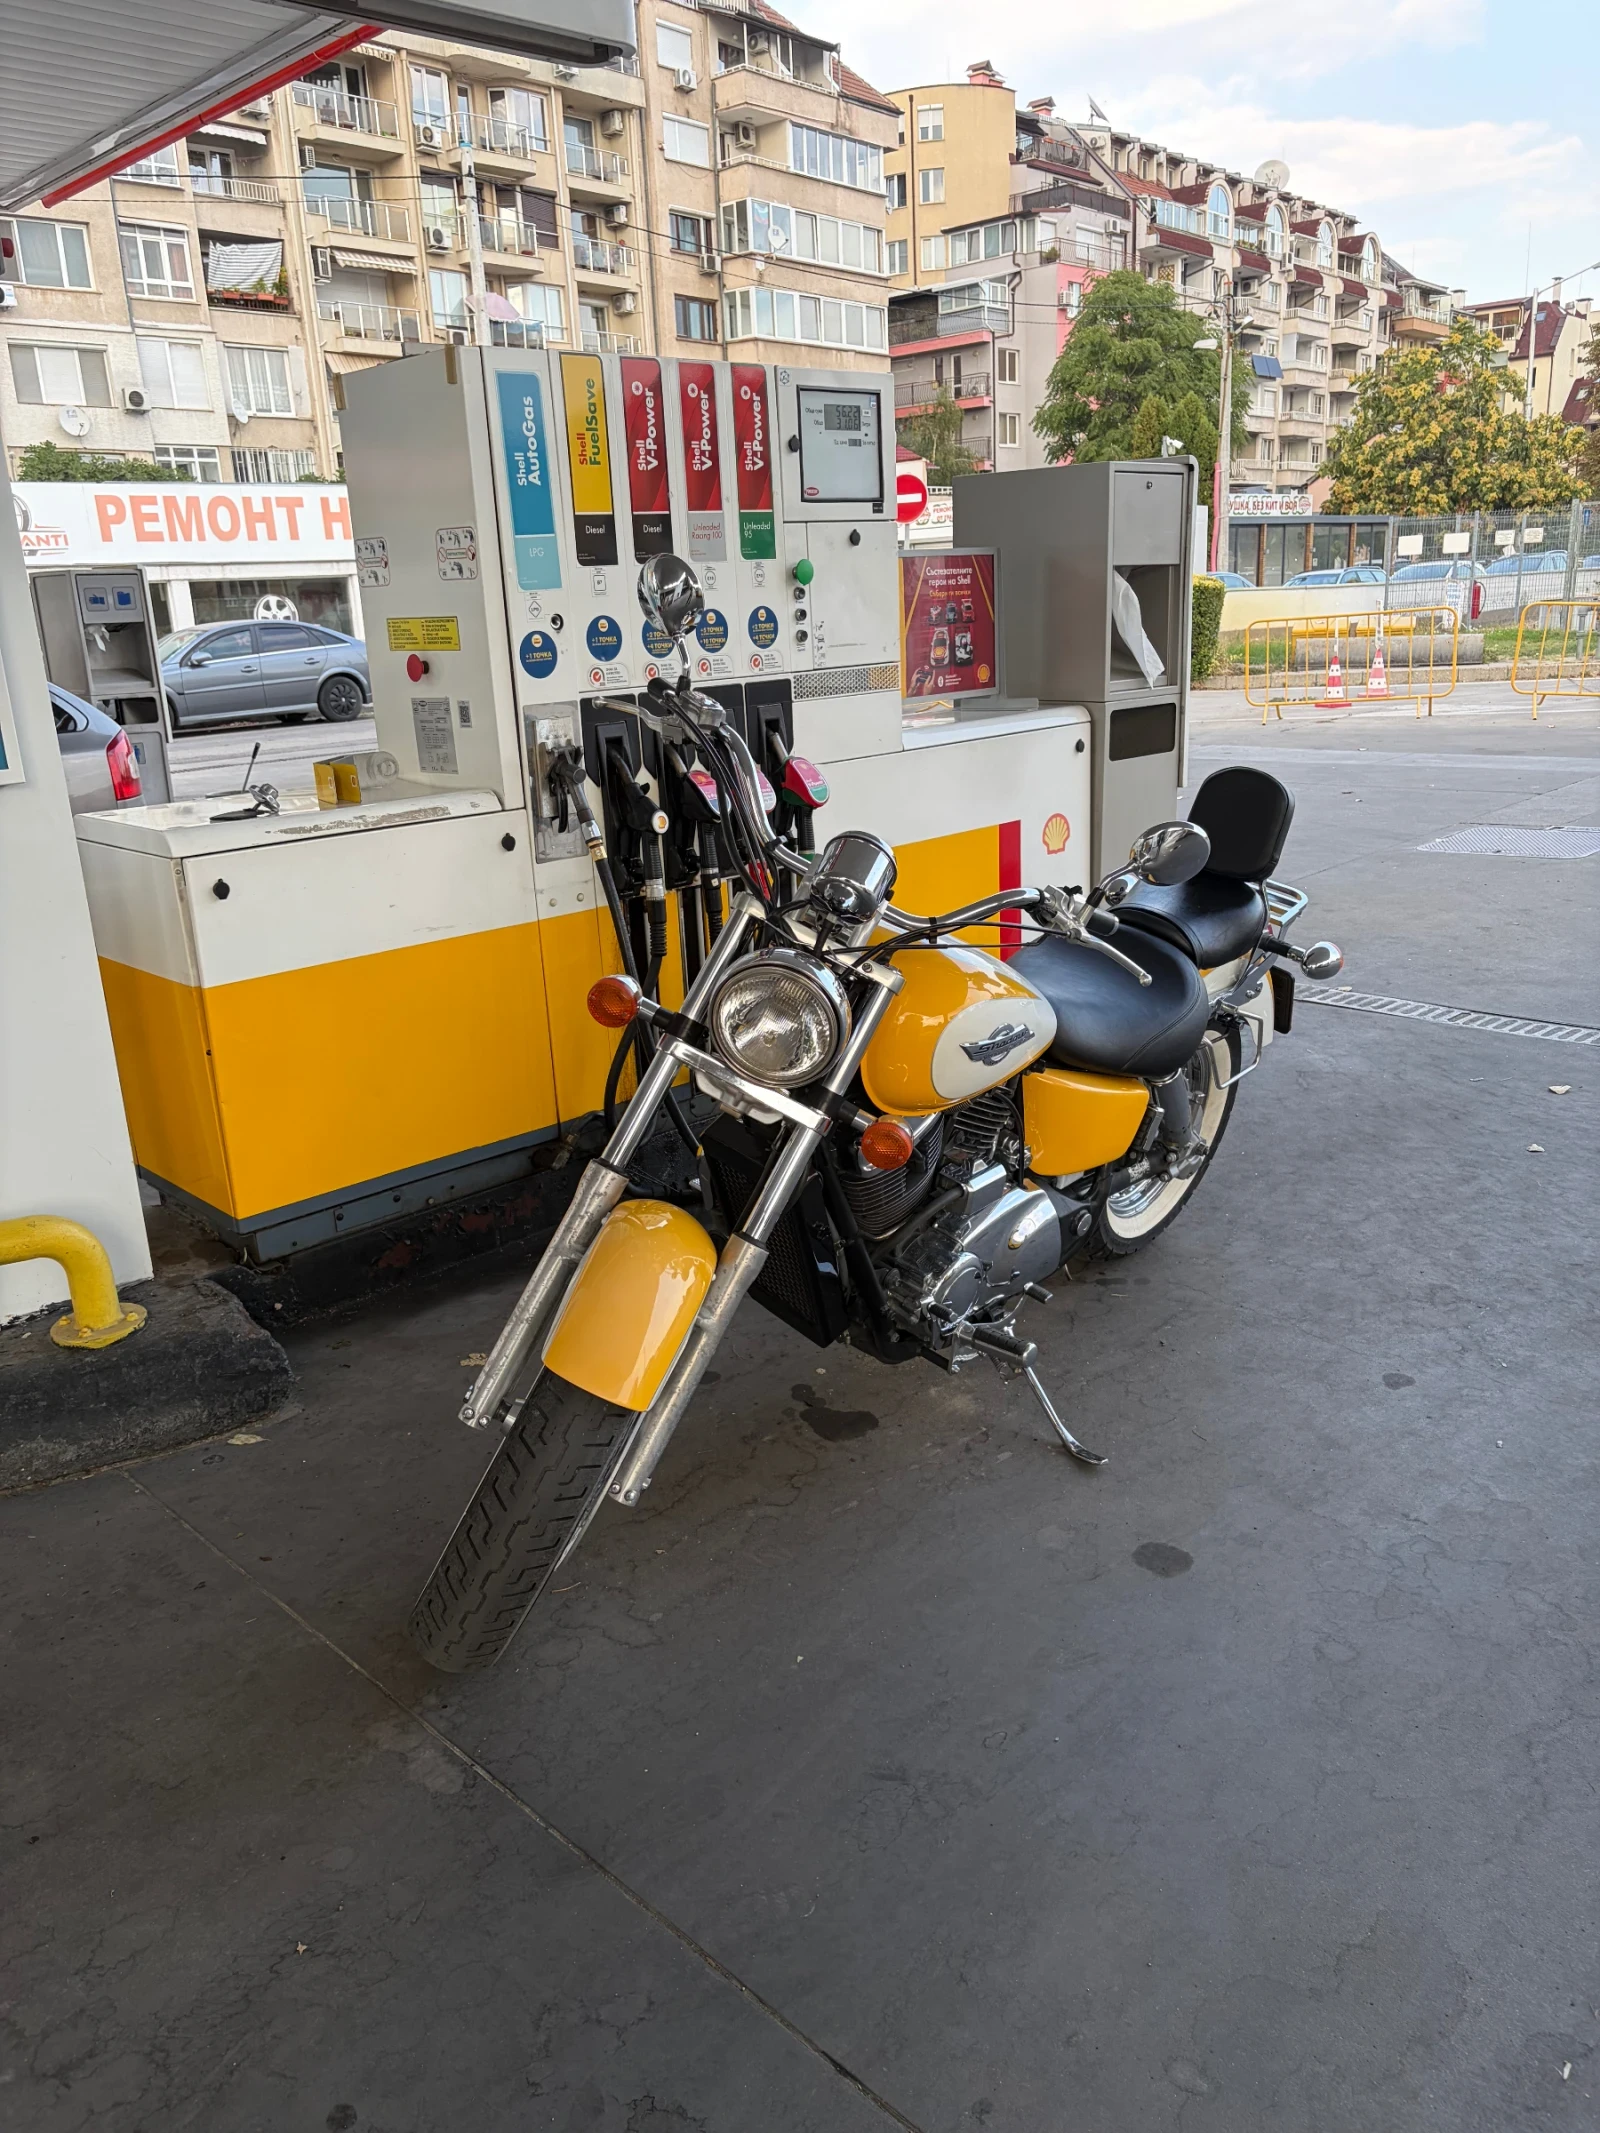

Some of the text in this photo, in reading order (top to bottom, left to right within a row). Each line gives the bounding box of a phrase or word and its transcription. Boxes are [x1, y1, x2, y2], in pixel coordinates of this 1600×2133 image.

[586, 378, 601, 466] FuelSave
[645, 387, 658, 471] V-Power
[700, 390, 713, 471] V-Power
[753, 392, 764, 471] V-Power
[523, 396, 541, 486] AutoGas
[577, 432, 588, 465] Shell
[635, 440, 646, 471] Shell
[691, 440, 701, 471] Shell
[744, 441, 753, 471] Shell
[514, 452, 527, 486] Shell
[94, 494, 304, 542] РЕМОНТ
[1252, 501, 1264, 510] БЕЗ
[1265, 501, 1278, 510] КИТ
[1279, 501, 1284, 510] И
[1285, 501, 1298, 510] БОЯ
[586, 525, 605, 534] Diesel
[642, 524, 662, 533] Diesel
[692, 531, 722, 540] Racing 100
[694, 523, 720, 531] Unleaded
[744, 522, 771, 530] Unleaded
[744, 530, 752, 538] 95
[530, 548, 544, 557] LPG
[928, 579, 947, 588] герои
[957, 575, 970, 584] Shell
